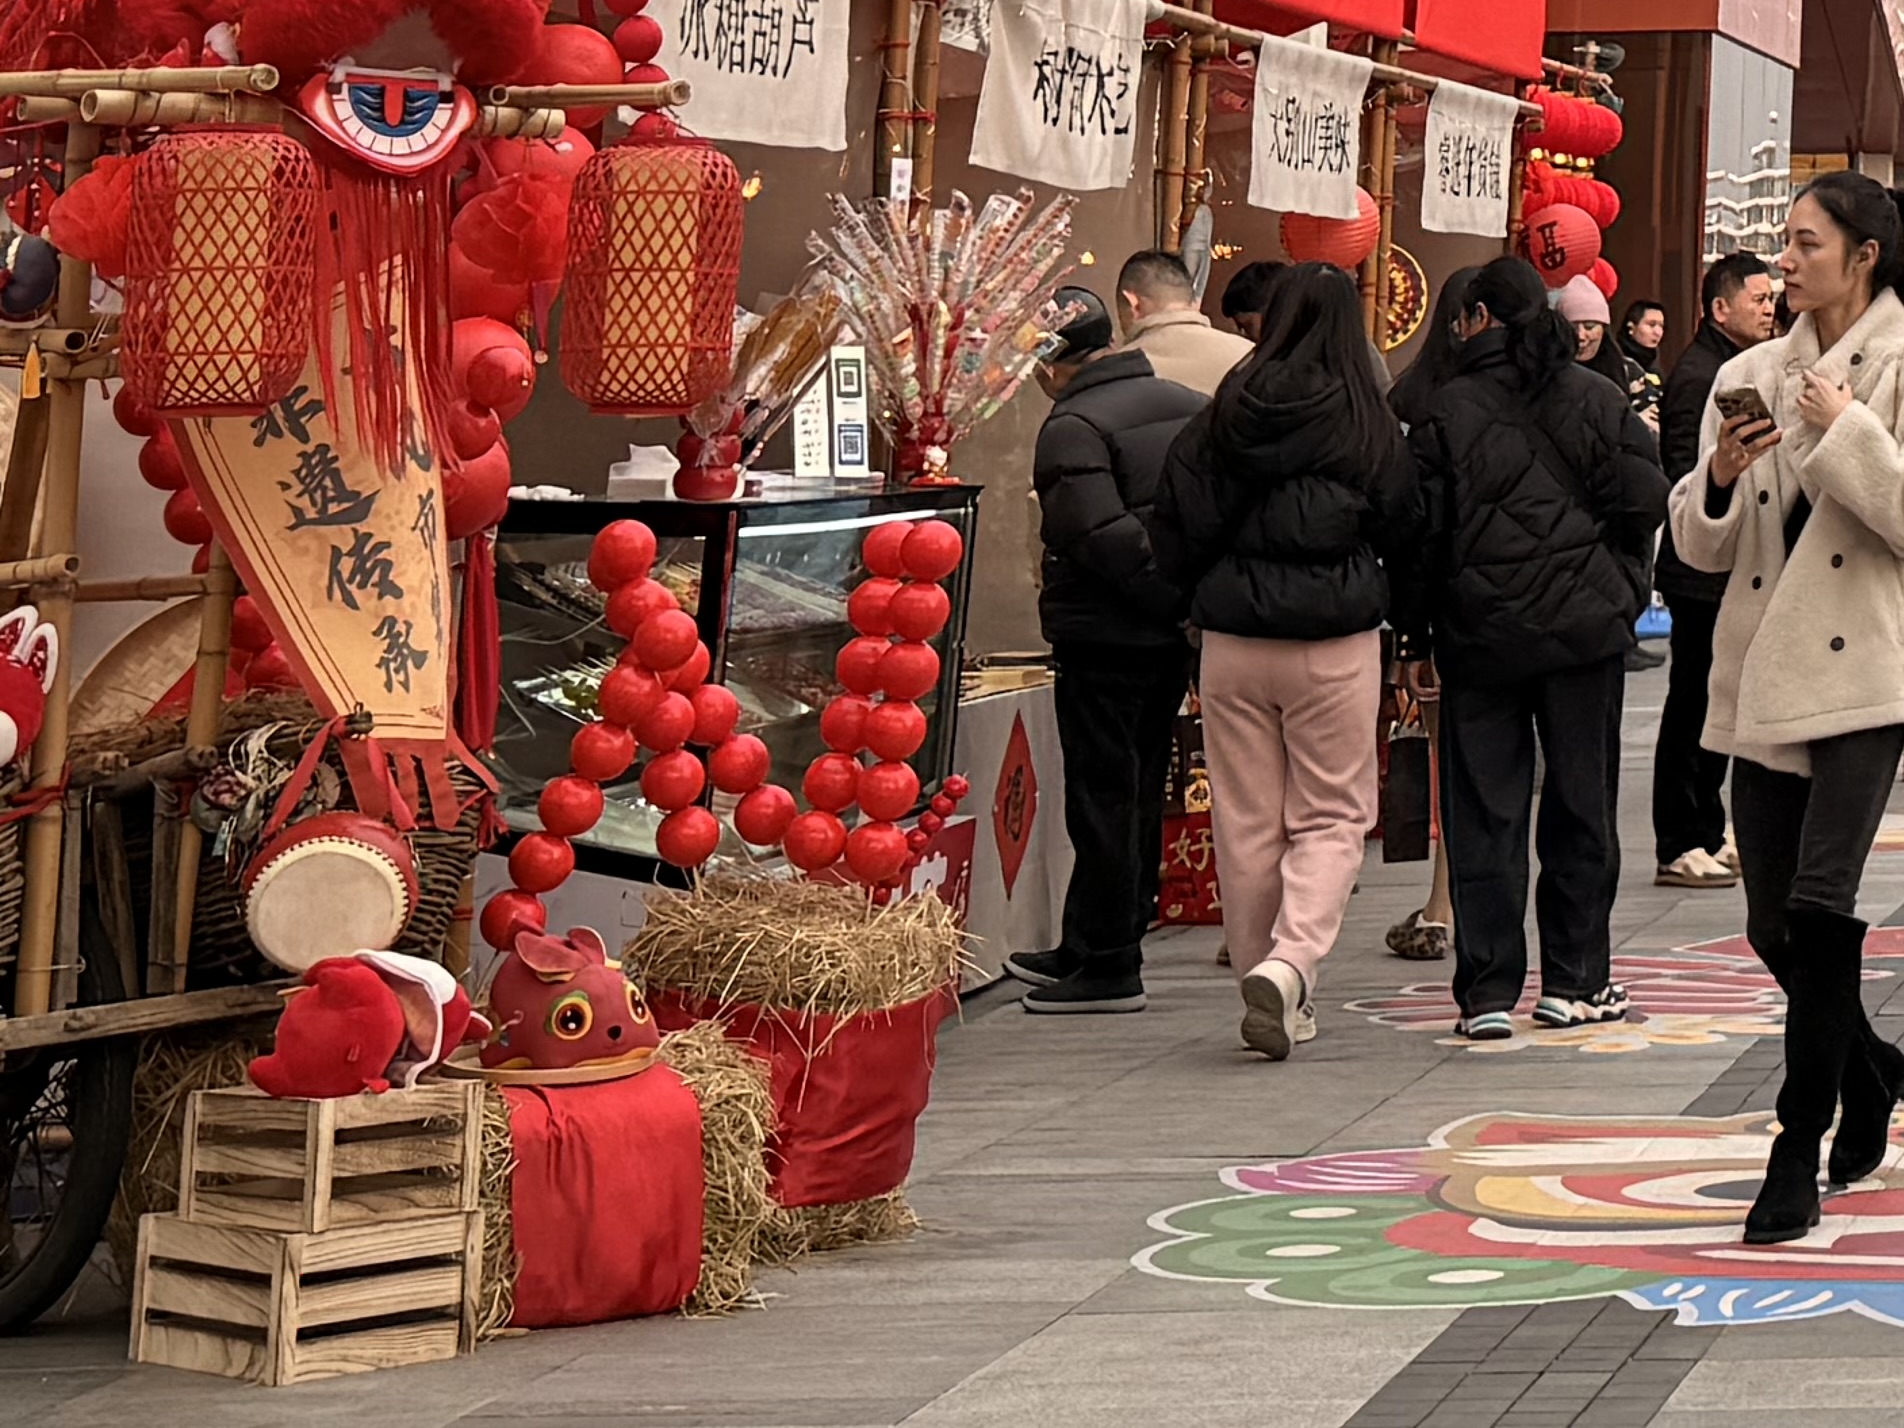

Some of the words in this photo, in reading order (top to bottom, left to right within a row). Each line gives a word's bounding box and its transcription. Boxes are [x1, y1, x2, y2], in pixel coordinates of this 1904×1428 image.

[1267, 94, 1352, 176] 大别山美味
